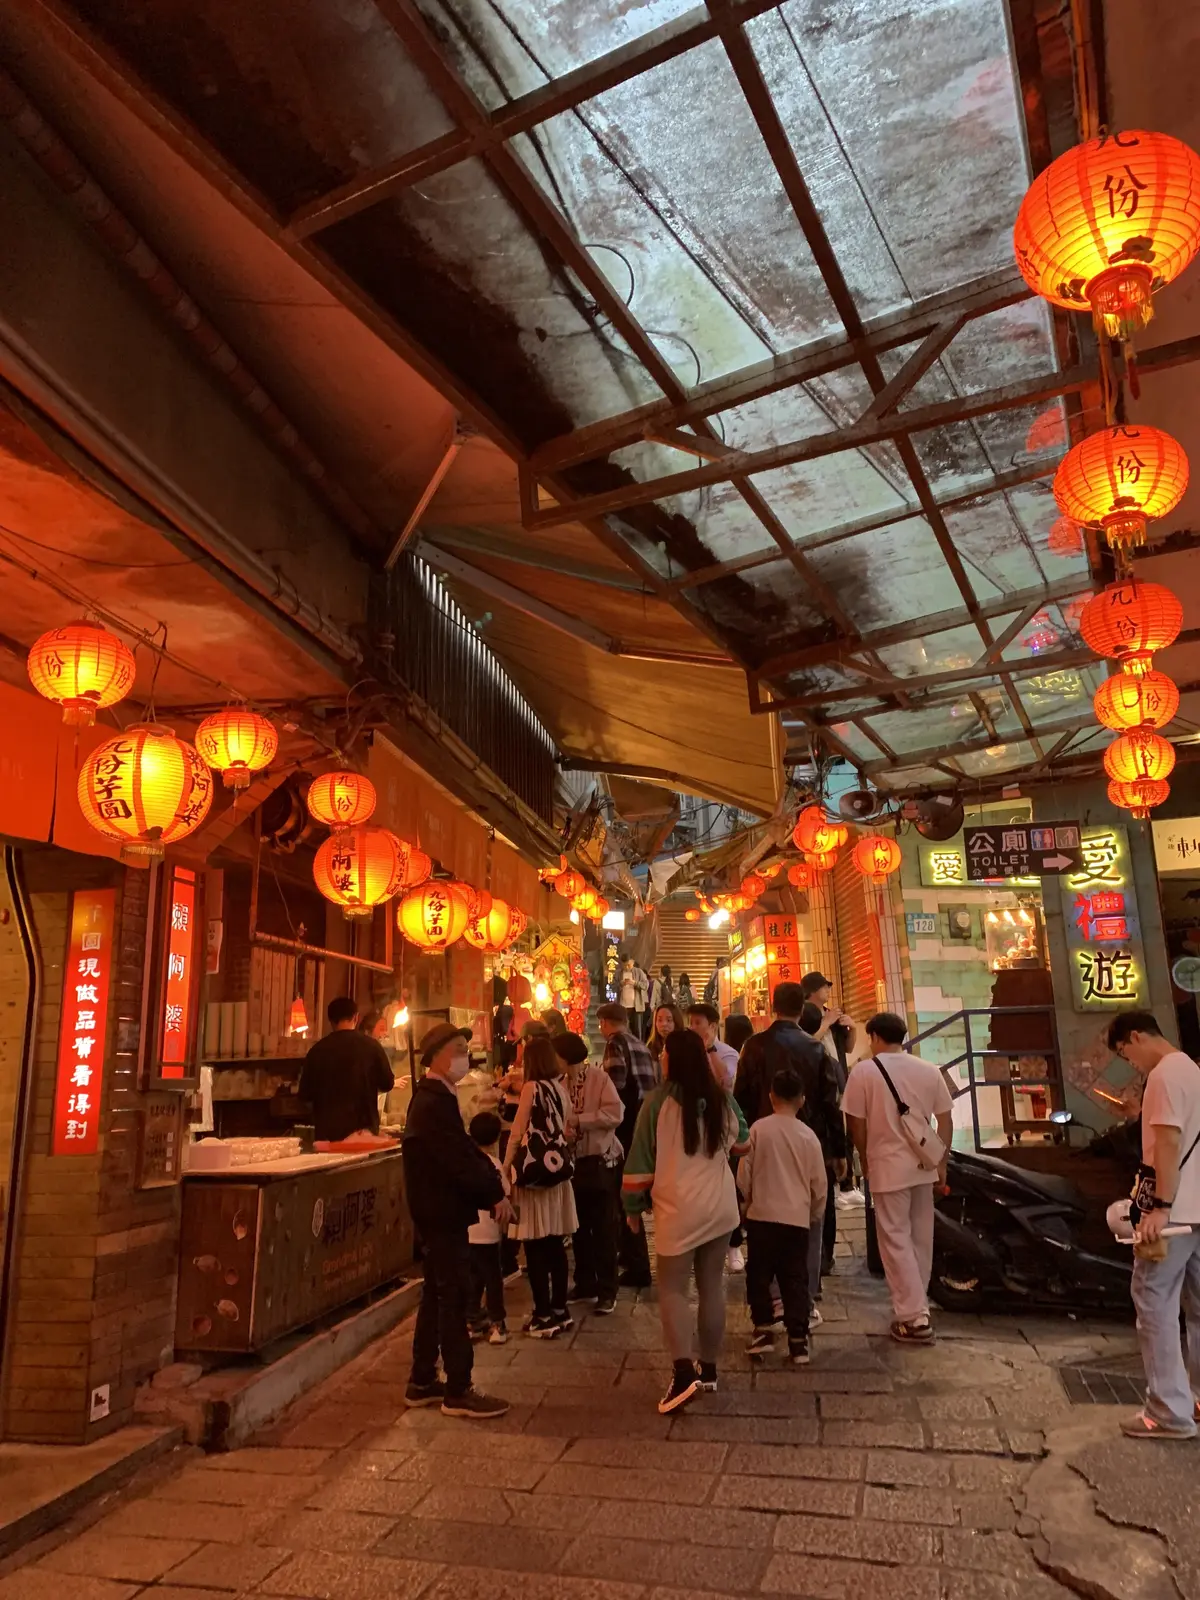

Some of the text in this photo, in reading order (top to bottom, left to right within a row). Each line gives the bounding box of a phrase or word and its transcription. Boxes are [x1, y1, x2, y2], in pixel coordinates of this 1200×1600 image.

[1097, 131, 1148, 219] 九份
[1111, 425, 1147, 484] 九份
[1111, 590, 1139, 640] 九份
[45, 629, 67, 679] 九份
[203, 716, 220, 756] 九份
[94, 740, 134, 819] 九份芋圓
[337, 774, 354, 812] 九份
[874, 840, 889, 870] 九份
[971, 854, 1030, 867] TOILET
[915, 920, 934, 932] 128
[1070, 832, 1137, 1001] 愛禮遊
[166, 903, 190, 1033] 賴阿婆
